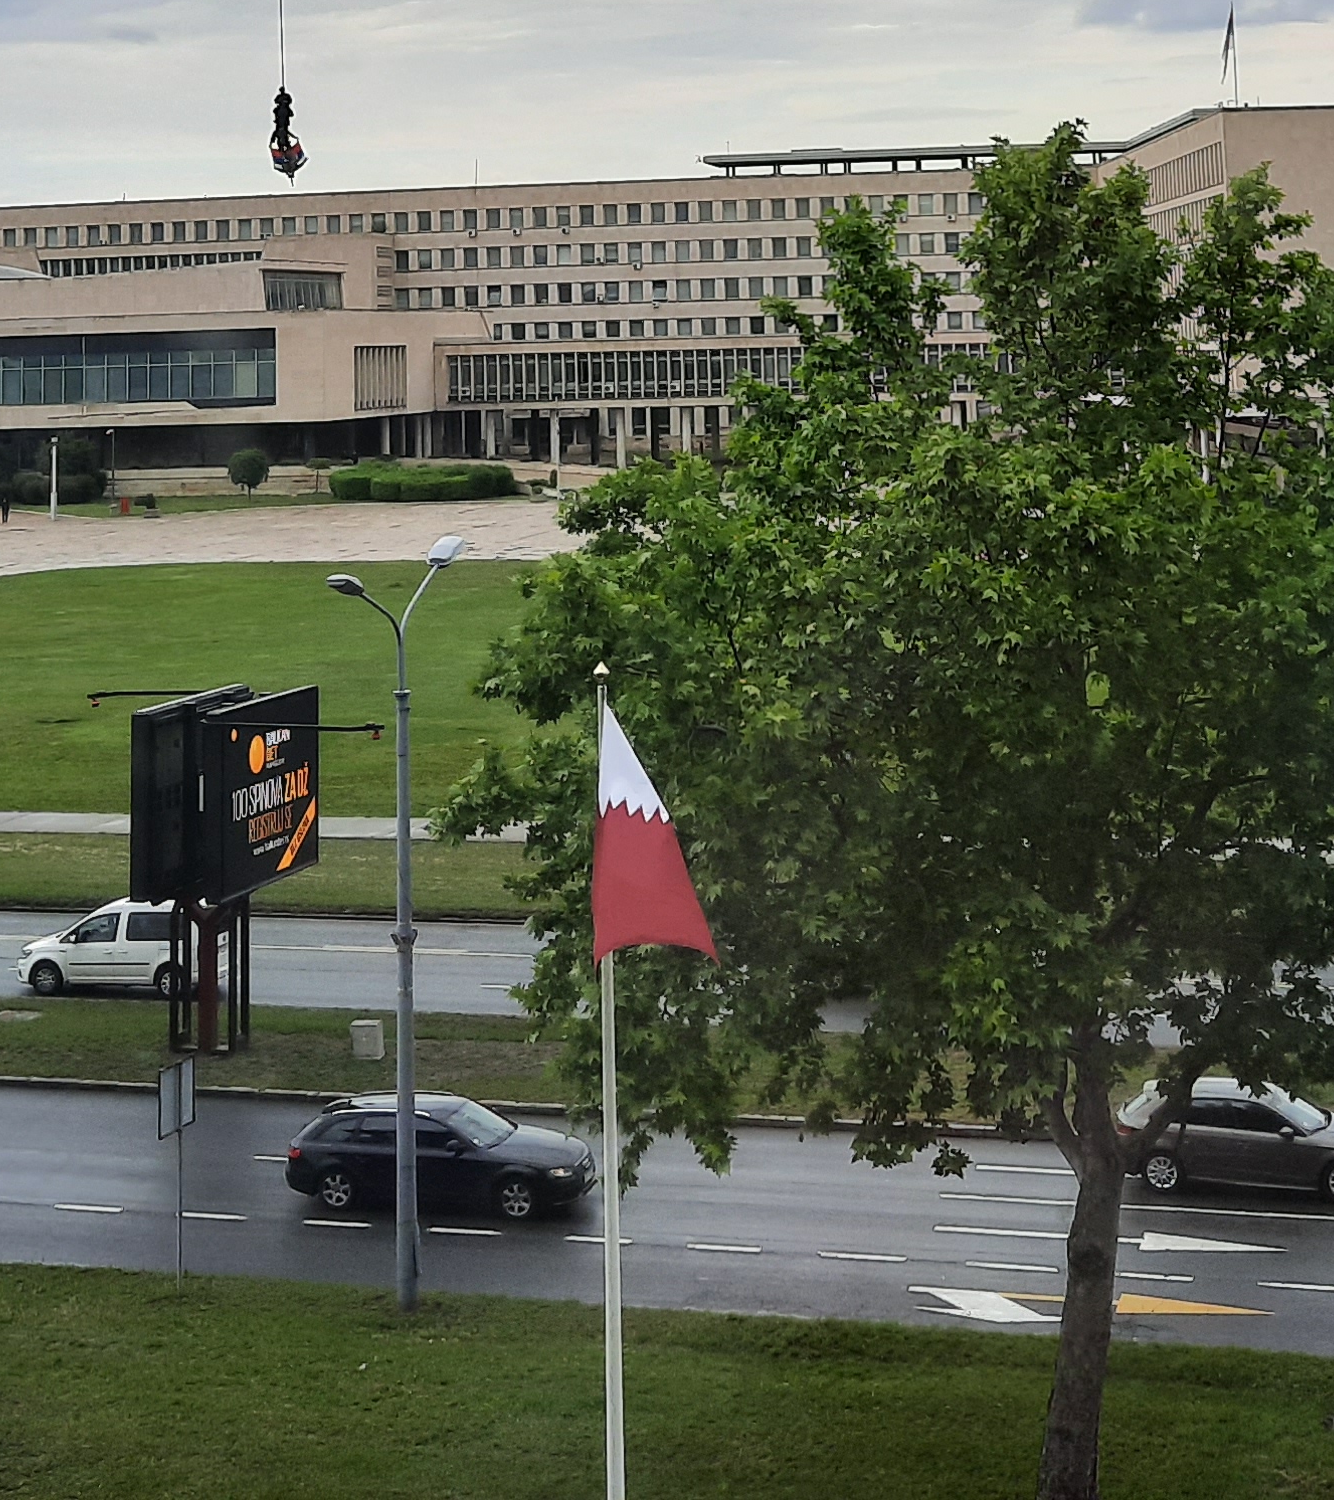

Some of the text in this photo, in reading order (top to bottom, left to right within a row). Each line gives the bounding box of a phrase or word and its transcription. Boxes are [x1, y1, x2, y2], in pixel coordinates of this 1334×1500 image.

[266, 745, 279, 762] BET
[232, 761, 309, 822] 100 SPINOVA ZA DŽ
[284, 804, 294, 830] SE
